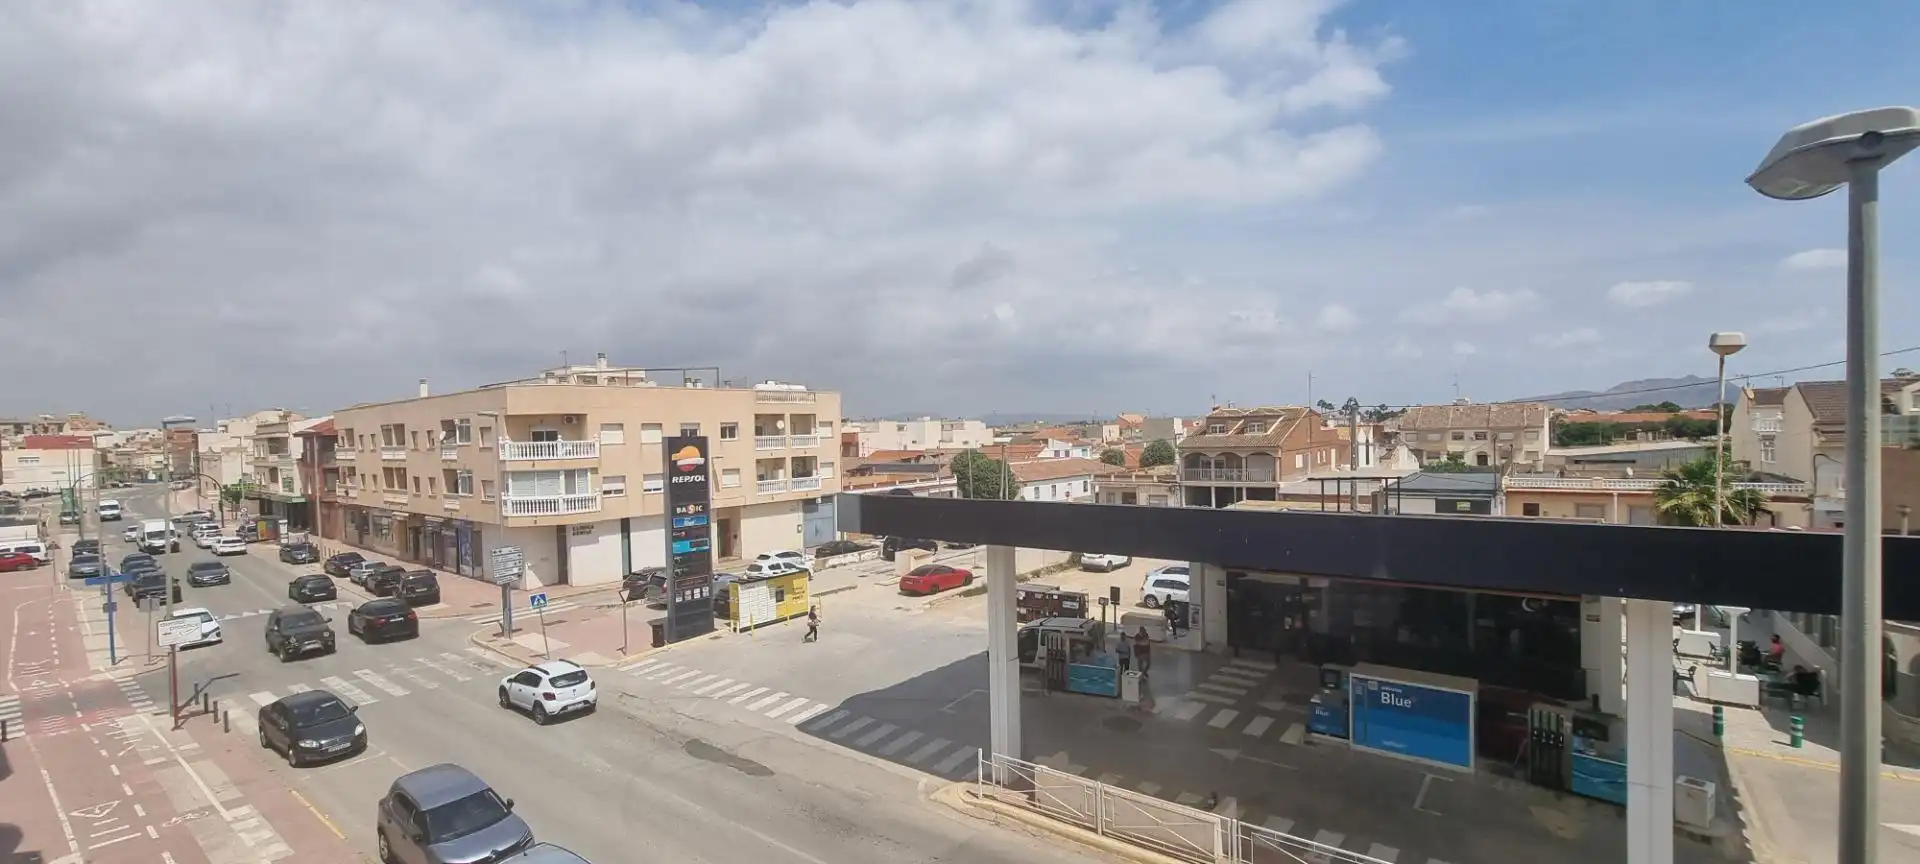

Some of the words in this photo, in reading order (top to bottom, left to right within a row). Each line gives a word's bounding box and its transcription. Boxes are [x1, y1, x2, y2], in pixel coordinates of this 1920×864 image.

[672, 475, 706, 483] REPSOL
[676, 504, 703, 514] BASIC
[1381, 692, 1411, 708] Blue
